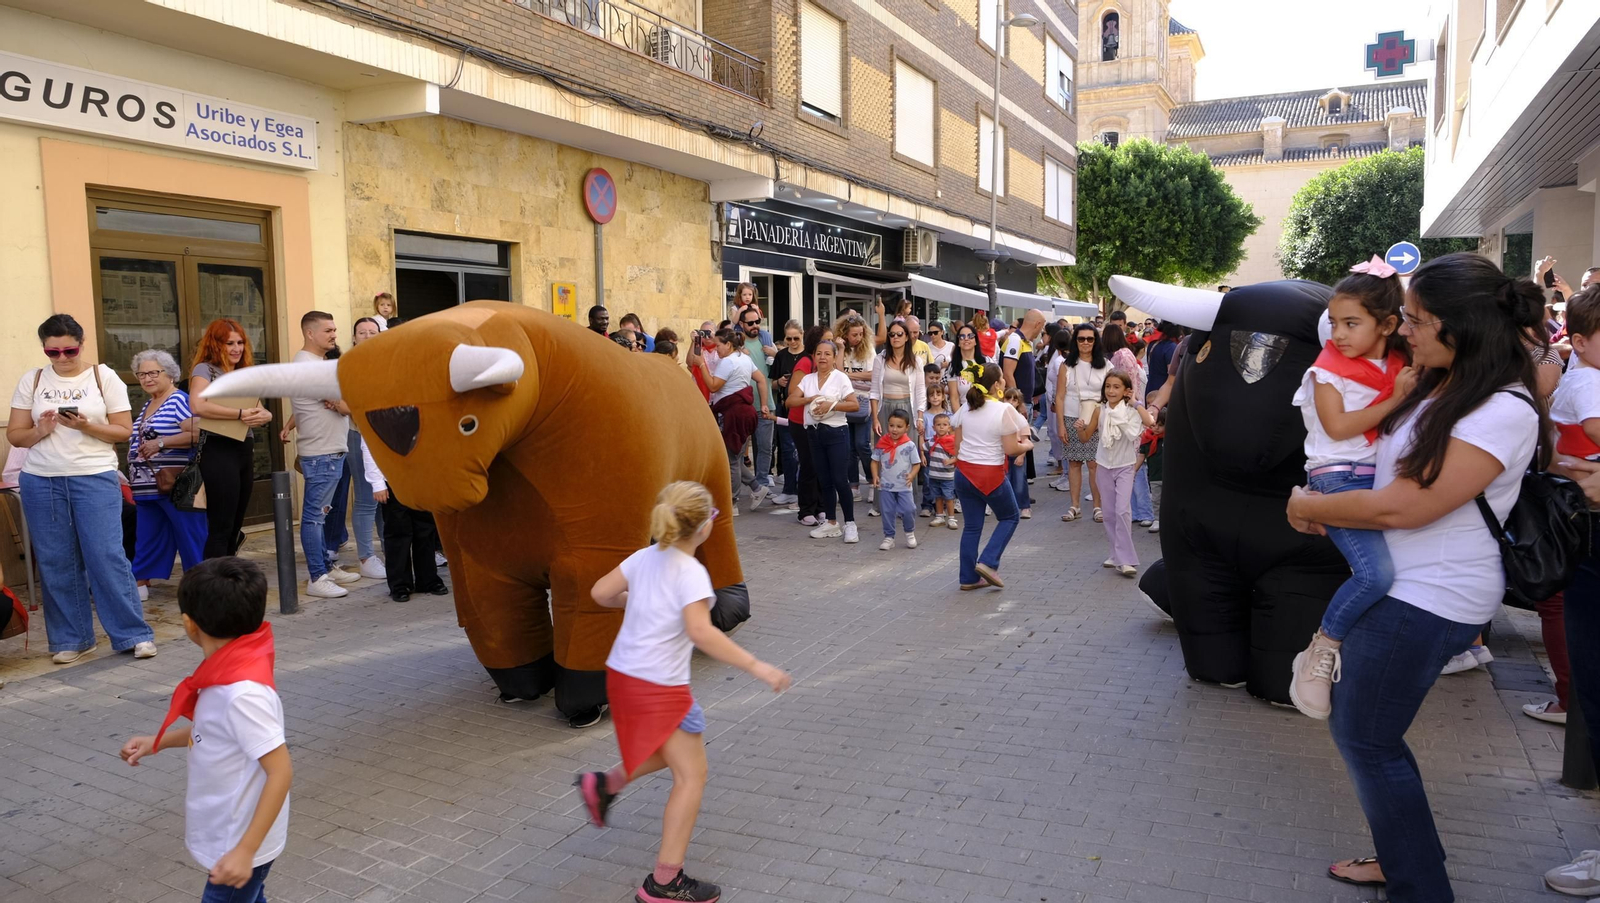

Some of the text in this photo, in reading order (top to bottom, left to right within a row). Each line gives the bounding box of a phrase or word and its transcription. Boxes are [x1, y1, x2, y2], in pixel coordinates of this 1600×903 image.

[0, 71, 177, 129] GUROS
[196, 102, 304, 138] Uribe y Egea
[186, 123, 312, 160] Asociados S.L.
[184, 246, 190, 255] 6
[744, 218, 868, 259] PANADERÍA ARGENTINA
